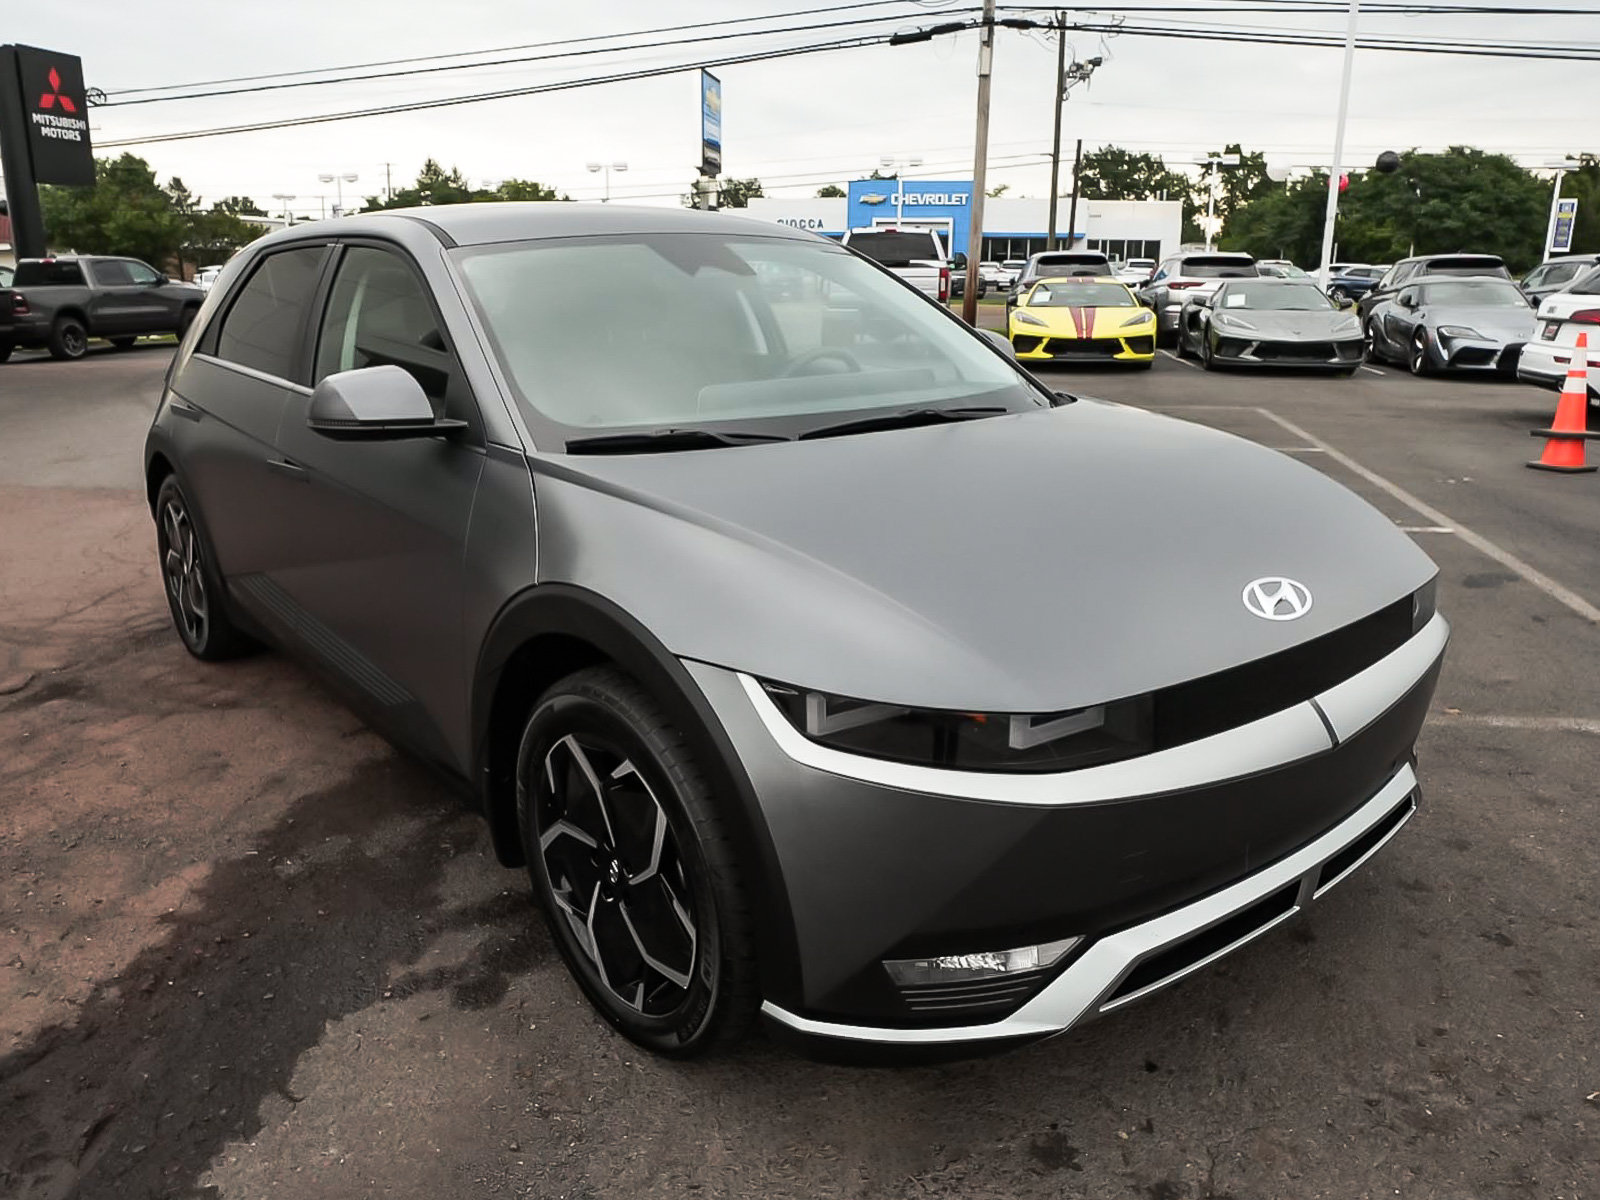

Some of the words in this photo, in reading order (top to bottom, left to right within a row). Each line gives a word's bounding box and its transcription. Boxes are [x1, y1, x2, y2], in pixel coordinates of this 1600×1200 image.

[32, 112, 86, 131] MITSUBISHI
[41, 126, 81, 142] MOTORS
[891, 193, 969, 205] CHEVROLET
